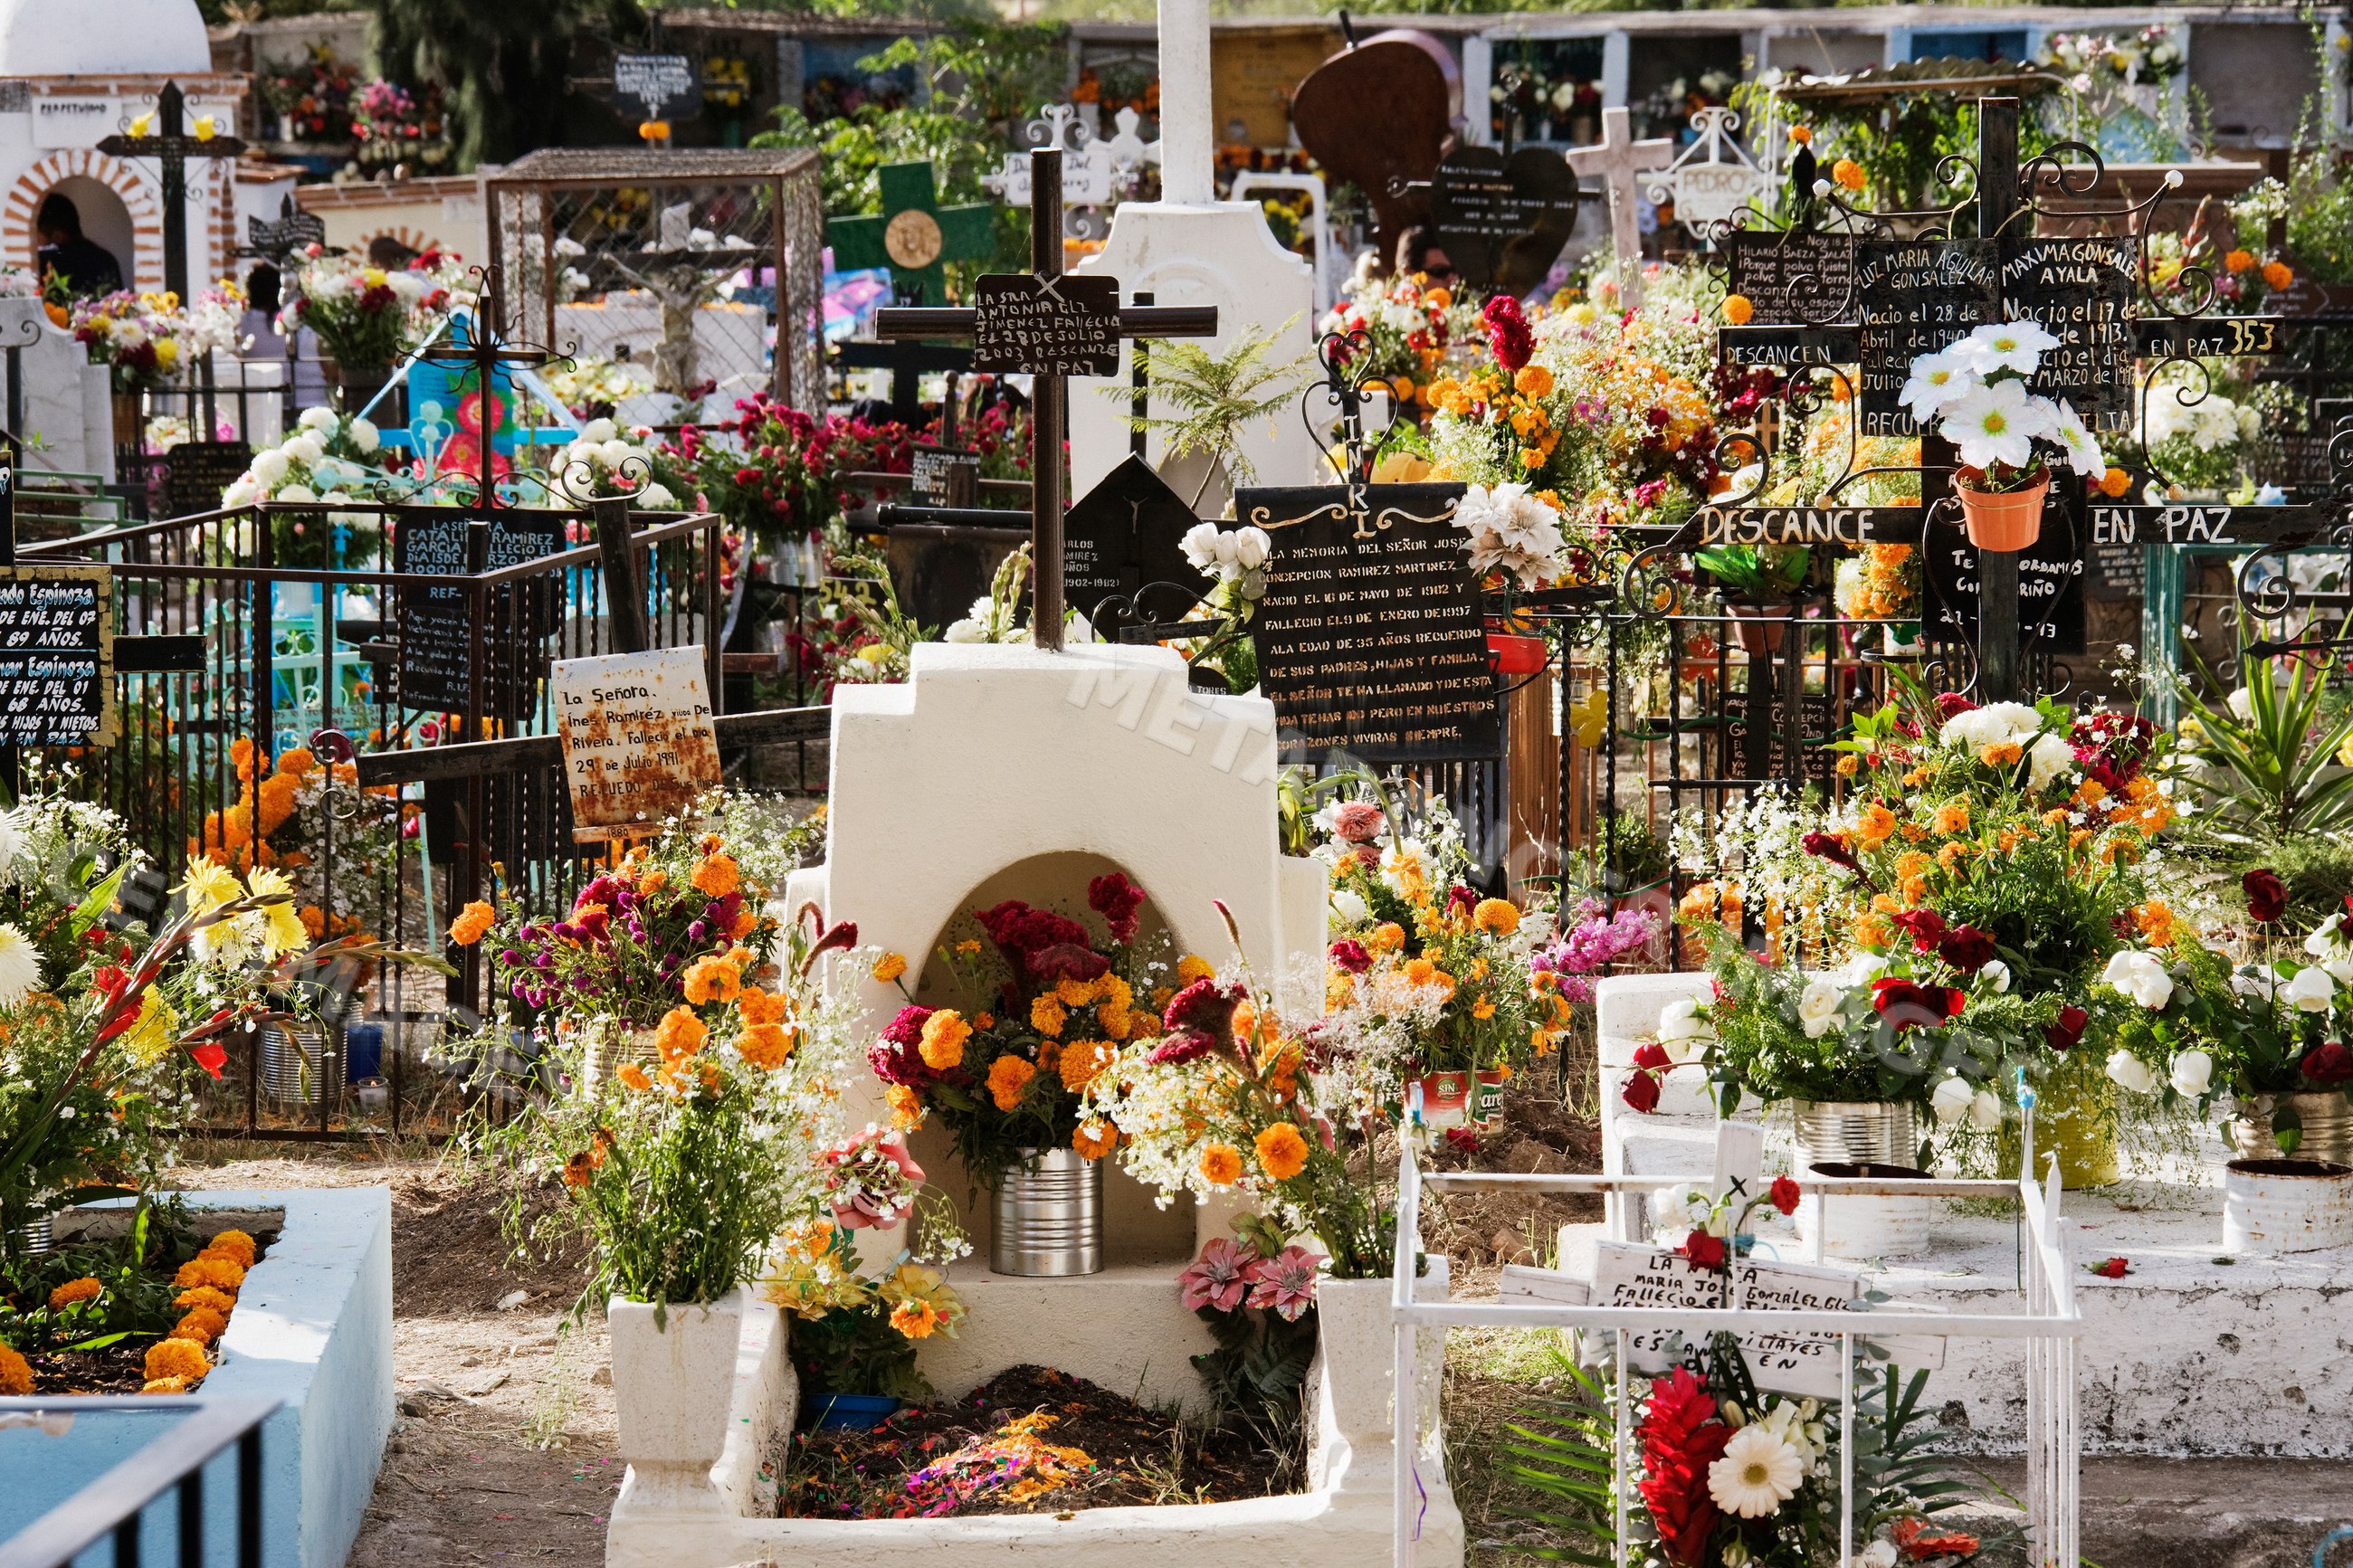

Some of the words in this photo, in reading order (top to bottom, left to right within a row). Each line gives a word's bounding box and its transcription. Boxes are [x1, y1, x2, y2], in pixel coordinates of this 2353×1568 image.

[1784, 261, 1814, 273] polvo
[1858, 261, 1884, 289] LUZ
[1885, 249, 1930, 271] MARIA
[1936, 249, 1995, 288] AGUILAR
[2002, 243, 2071, 287] MAXIMA
[1745, 272, 1776, 285] polvo
[1891, 271, 1965, 290] GONSALEZ
[2040, 266, 2098, 284] AYALA
[976, 301, 1053, 320] ANTONIA
[1910, 303, 1927, 322] el
[1935, 304, 1952, 322] 28
[1959, 304, 1979, 321] de
[2072, 298, 2091, 322] el
[2099, 301, 2115, 322] 17
[2121, 297, 2137, 320] de
[1860, 328, 1893, 348] Abril
[1908, 328, 1928, 347] de
[2057, 323, 2080, 345] de
[2226, 319, 2275, 355] 353
[976, 347, 1024, 362] 2003
[2151, 339, 2176, 356] EN
[2187, 337, 2225, 356] PAZ
[1019, 363, 1048, 374] EN
[1056, 360, 1102, 376] PAZ
[2037, 364, 2088, 387] MARZO
[2093, 366, 2110, 384] de
[1697, 506, 1878, 545] DESCANCE
[2093, 508, 2136, 543] EN
[2164, 507, 2235, 543] PAZ
[1358, 544, 1381, 555] DEL
[1386, 537, 1427, 553] SEÑOR
[1338, 565, 1391, 578] RAMIREZ
[1396, 560, 1456, 575] MARTINEZ
[30, 582, 94, 611] Espinoza
[1262, 594, 1297, 607] NACIO
[1304, 594, 1319, 604] EL
[1339, 592, 1355, 603] DE
[1359, 589, 1389, 602] MAYO
[1397, 586, 1413, 598] DE
[1455, 583, 1463, 594] Y
[52, 611, 74, 626] DEL
[79, 611, 96, 625] 07
[1356, 612, 1372, 623] DE
[1380, 609, 1420, 622] ENERO
[6, 632, 30, 647] 89
[1300, 641, 1330, 652] EDAD
[1336, 639, 1353, 650] DE
[1377, 632, 1411, 646] AÑOS
[1415, 628, 1481, 643] RECUERDO
[28, 655, 95, 681] Espinoza
[1269, 667, 1287, 678] DE
[1291, 665, 1314, 677] SUS
[43, 680, 66, 695] DEL
[73, 680, 89, 695] 01
[1289, 685, 1332, 701] SEÑOR
[1337, 686, 1354, 698] TE
[564, 691, 583, 705] La
[1369, 707, 1404, 718] PERO
[1406, 705, 1424, 717] EN
[1426, 699, 1495, 715] NUESTROS
[12, 715, 43, 730] HIJOS
[48, 716, 57, 730] Y
[16, 731, 37, 746] EN
[46, 731, 83, 746] PAZ
[674, 727, 686, 740] el
[576, 758, 595, 774] 29
[657, 752, 679, 766] 1991
[1649, 1256, 1672, 1270] LA
